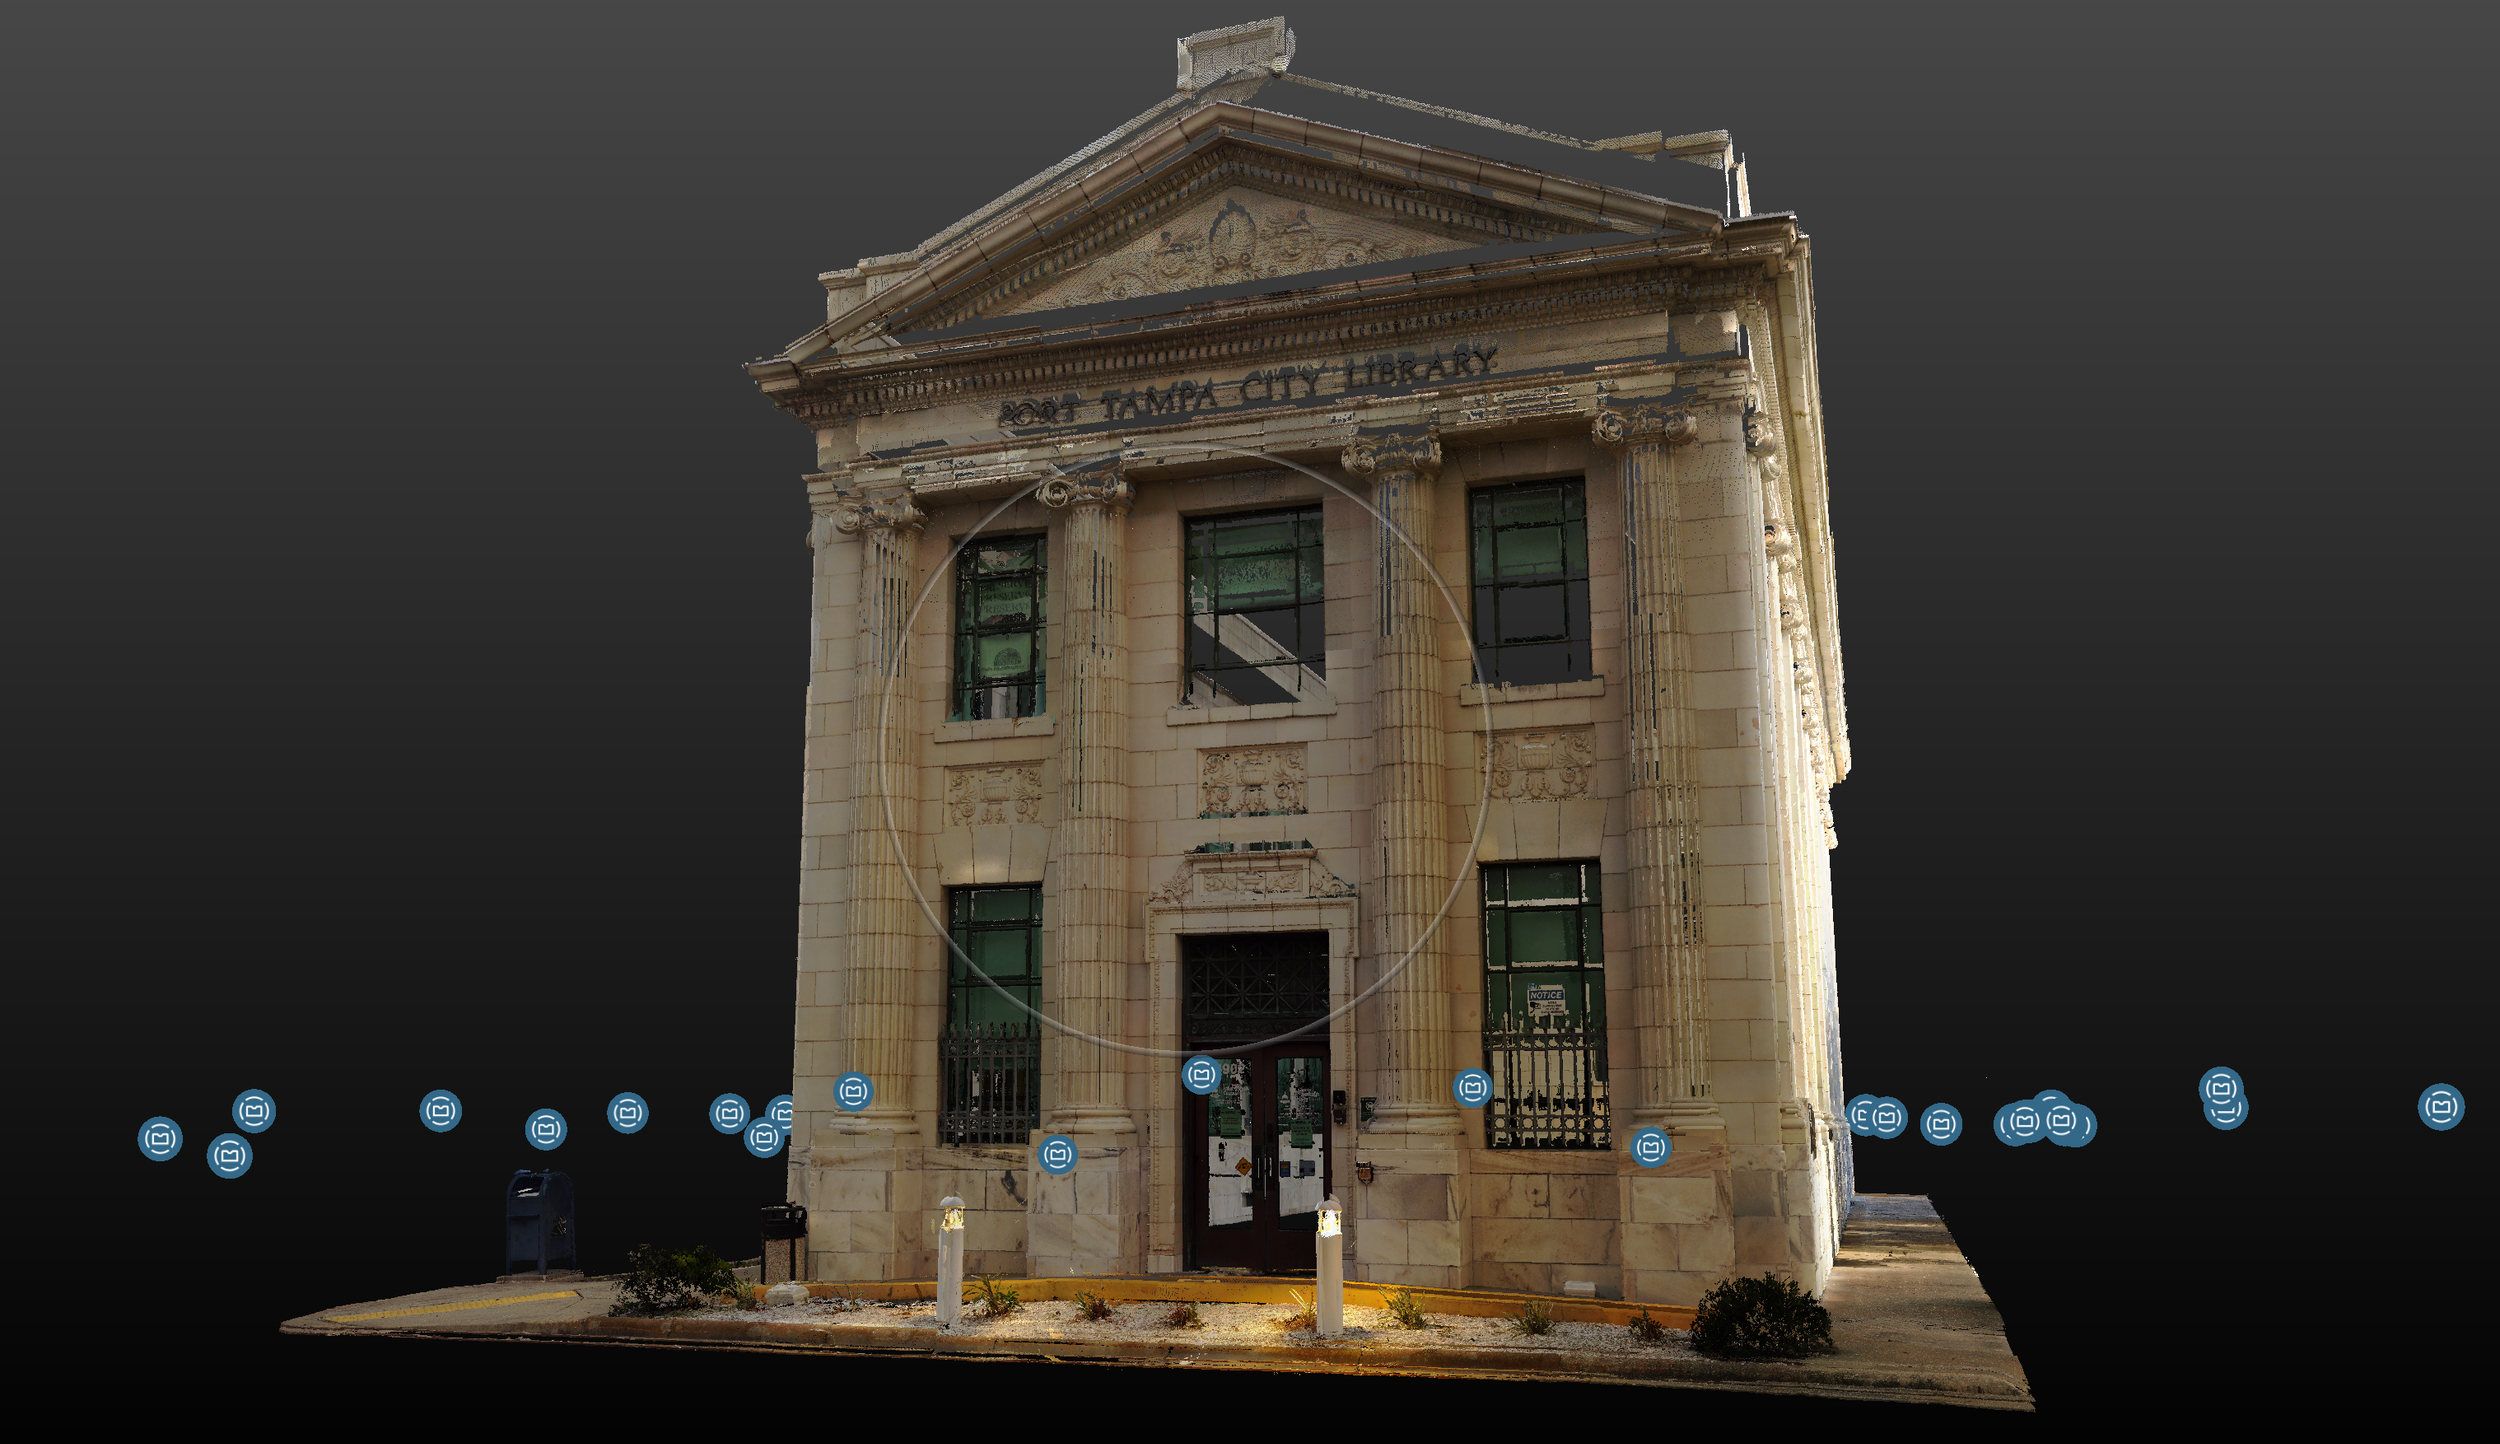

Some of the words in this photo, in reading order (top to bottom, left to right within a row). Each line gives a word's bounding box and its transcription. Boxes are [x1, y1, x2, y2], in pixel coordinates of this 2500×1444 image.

[998, 400, 1080, 427] PORT
[1101, 386, 1218, 419] TAMPA
[1240, 372, 1320, 401] CITY
[1346, 348, 1498, 388] LIBRARY
[1530, 991, 1562, 999] NOTICE
[1219, 1063, 1245, 1074] 902
